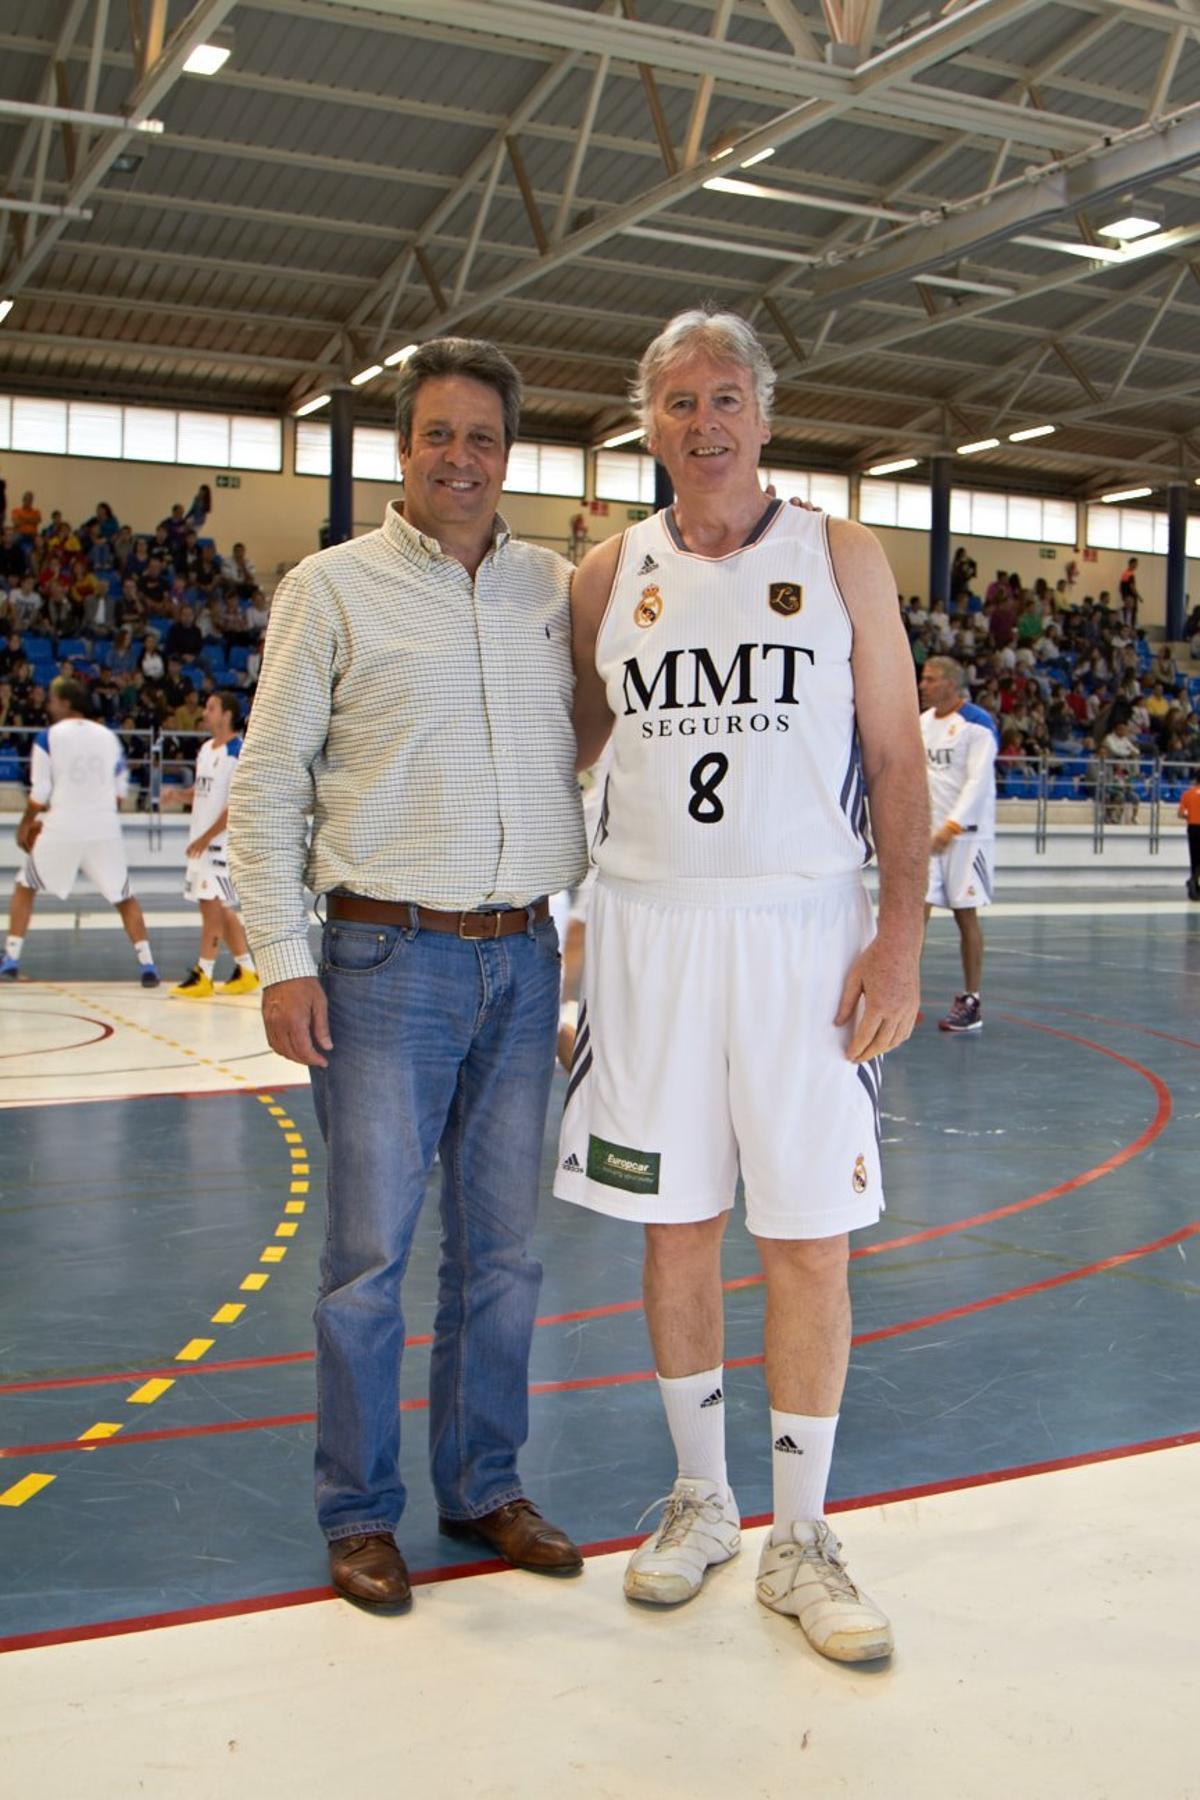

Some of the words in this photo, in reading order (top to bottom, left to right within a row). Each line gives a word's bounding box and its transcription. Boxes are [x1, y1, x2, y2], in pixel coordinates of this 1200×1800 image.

[623, 643, 815, 716] MMT
[642, 713, 790, 739] SEGUROS
[688, 752, 729, 824] 8
[607, 1153, 650, 1172] Europcar
